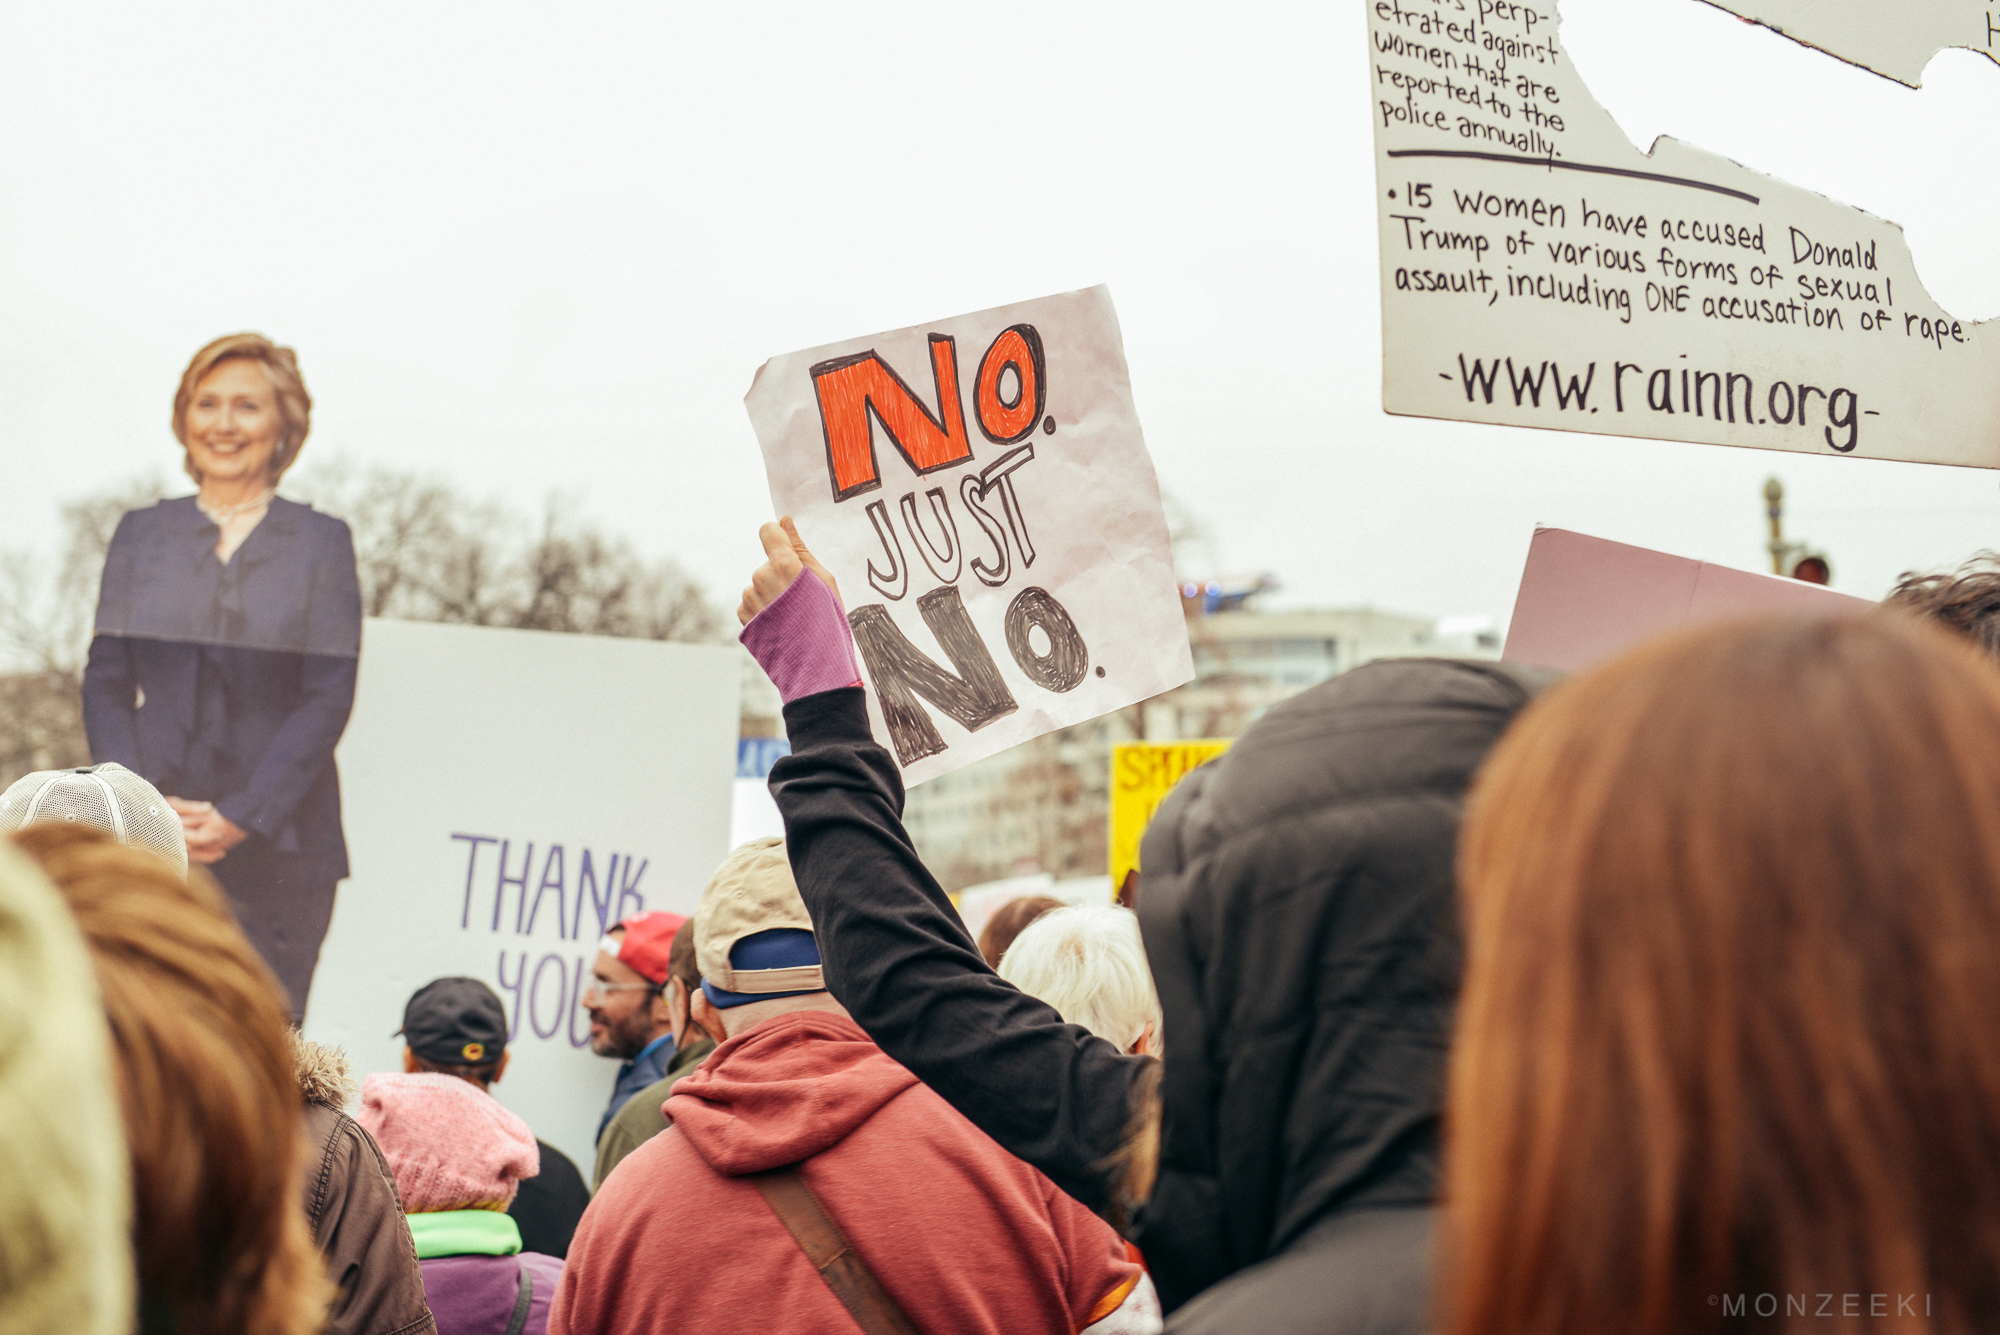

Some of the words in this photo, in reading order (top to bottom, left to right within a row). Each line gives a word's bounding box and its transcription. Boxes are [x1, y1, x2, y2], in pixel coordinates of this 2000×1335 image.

[1375, 0, 1476, 44] etrated
[1482, 31, 1558, 70] against
[1478, 0, 1548, 34] perp-
[1375, 31, 1457, 69] women
[1463, 54, 1510, 88] that
[1517, 75, 1559, 103] are
[1377, 65, 1481, 108] reported
[1485, 92, 1510, 118] to
[1519, 102, 1564, 132] the
[1380, 98, 1450, 128] police
[1456, 117, 1561, 170] annually.
[1389, 215, 1489, 263] Trump
[1507, 231, 1534, 255] of
[1548, 242, 1646, 272] various
[1657, 247, 1737, 285] forms
[1751, 265, 1783, 289] of
[1798, 275, 1892, 306] sexual
[1407, 182, 1432, 208] 15
[1454, 189, 1565, 228] women
[1582, 198, 1647, 238] have
[1661, 219, 1765, 254] accused
[1789, 226, 1877, 271] Donald
[1395, 269, 1498, 307] assault,
[1507, 265, 1631, 323] including
[1646, 282, 1690, 312] ONE
[1703, 297, 1843, 330] accusation
[1861, 309, 1892, 330] of
[1905, 312, 1970, 350] rape.
[809, 323, 1056, 503] NO.
[865, 442, 1036, 601] JUST
[846, 585, 1106, 768] NO.
[451, 834, 648, 940] THANK
[499, 950, 592, 1048] YOU
